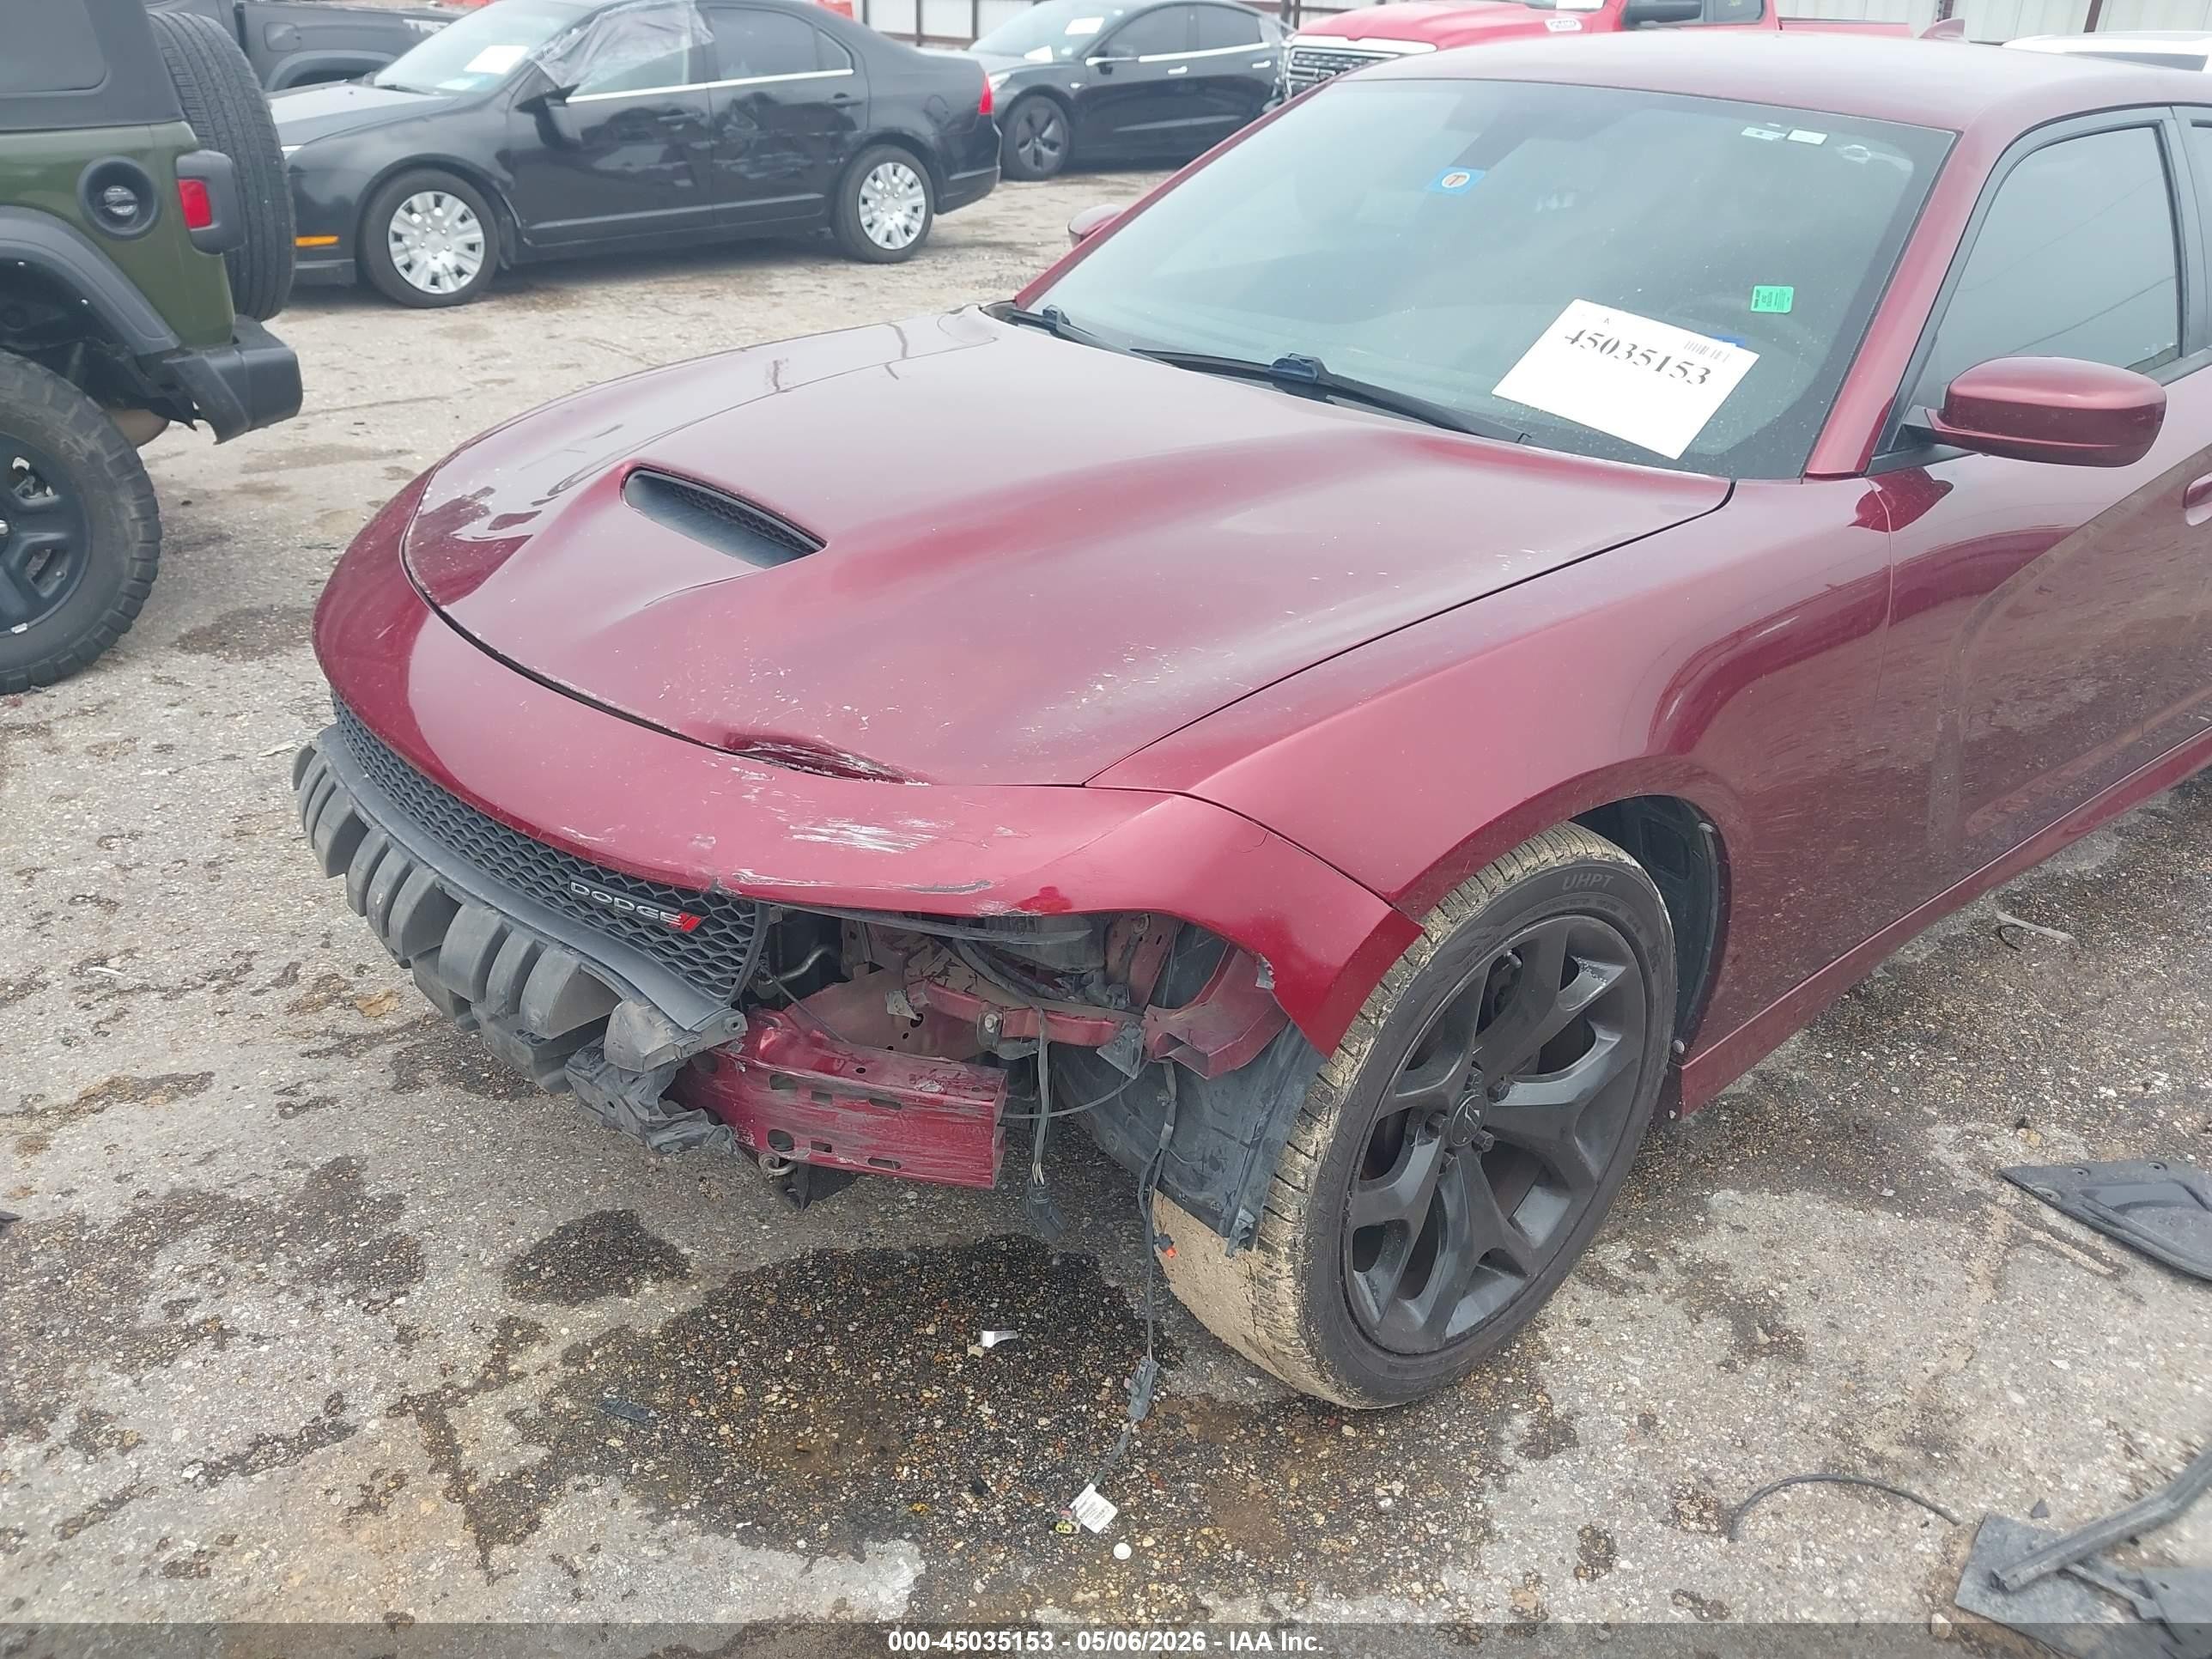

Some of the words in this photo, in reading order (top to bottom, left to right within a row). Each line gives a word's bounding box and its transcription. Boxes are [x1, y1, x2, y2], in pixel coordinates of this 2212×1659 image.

[1564, 329, 1711, 385] 45035153
[1562, 872, 1614, 891] UHPT
[570, 882, 683, 927] DODGE
